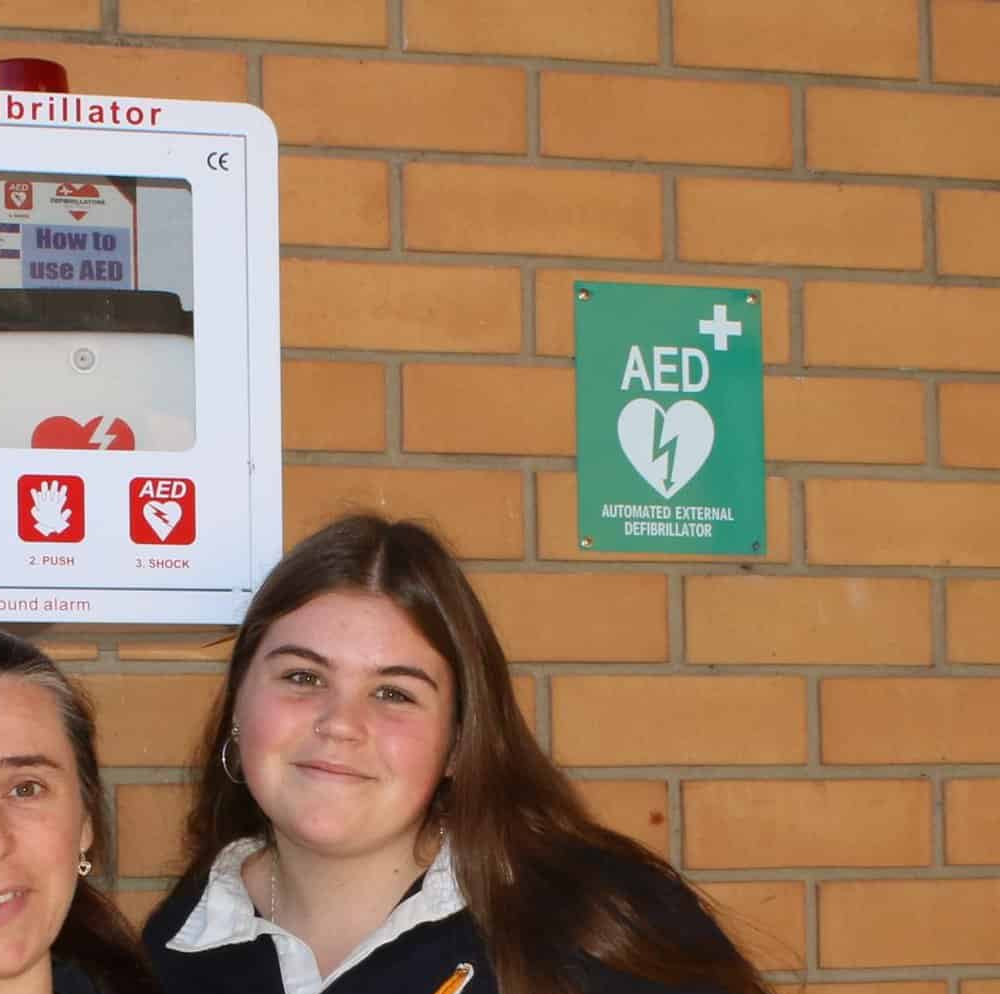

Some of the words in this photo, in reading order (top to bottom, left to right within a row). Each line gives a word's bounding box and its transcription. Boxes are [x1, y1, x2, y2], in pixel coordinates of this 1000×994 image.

[36, 227, 88, 250] How
[93, 231, 117, 251] to
[29, 261, 74, 280] use
[79, 260, 123, 281] AED
[620, 344, 710, 393] AED
[138, 480, 188, 499] AED
[602, 503, 671, 520] AUTOMATED
[675, 506, 735, 521] EXTERNAL
[624, 521, 712, 538] DEFIBRILLATOR
[29, 557, 40, 566] 2.
[42, 556, 75, 566] PUSH
[135, 558, 146, 569] 3.
[148, 559, 190, 569] SHOCK
[43, 600, 91, 612] alarm
